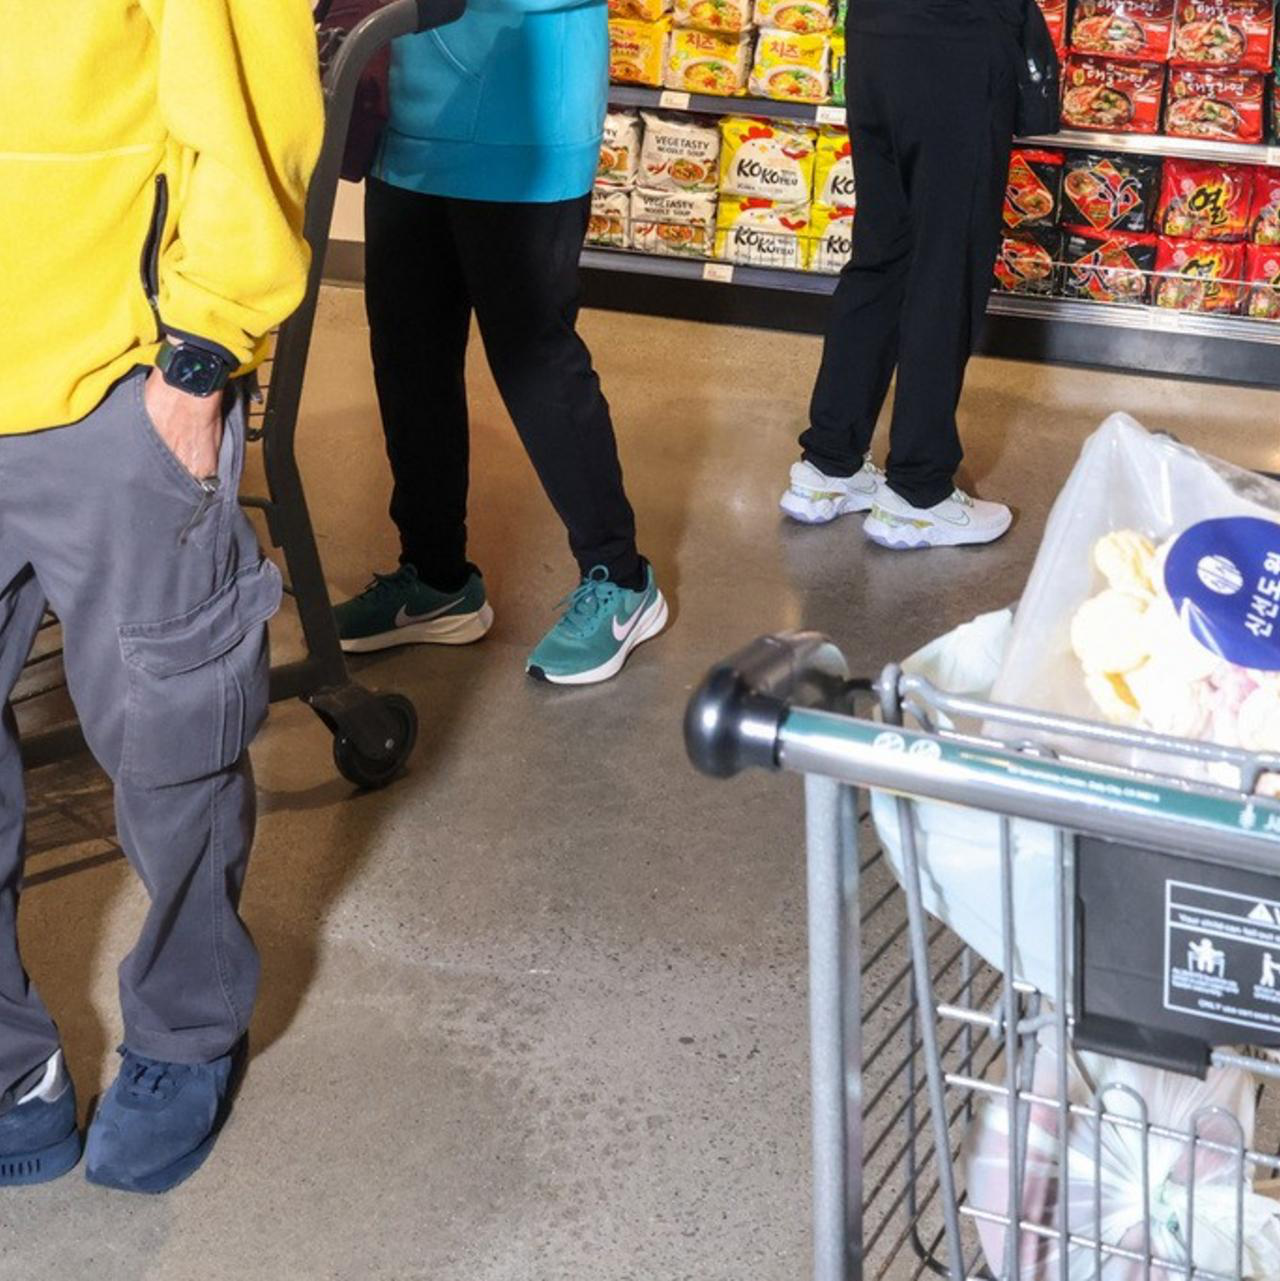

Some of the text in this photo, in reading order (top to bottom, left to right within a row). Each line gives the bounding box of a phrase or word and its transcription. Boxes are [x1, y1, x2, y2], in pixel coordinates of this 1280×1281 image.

[686, 32, 715, 50] 치즈
[770, 41, 800, 58] 치즈
[655, 136, 711, 151] VEGETASTY
